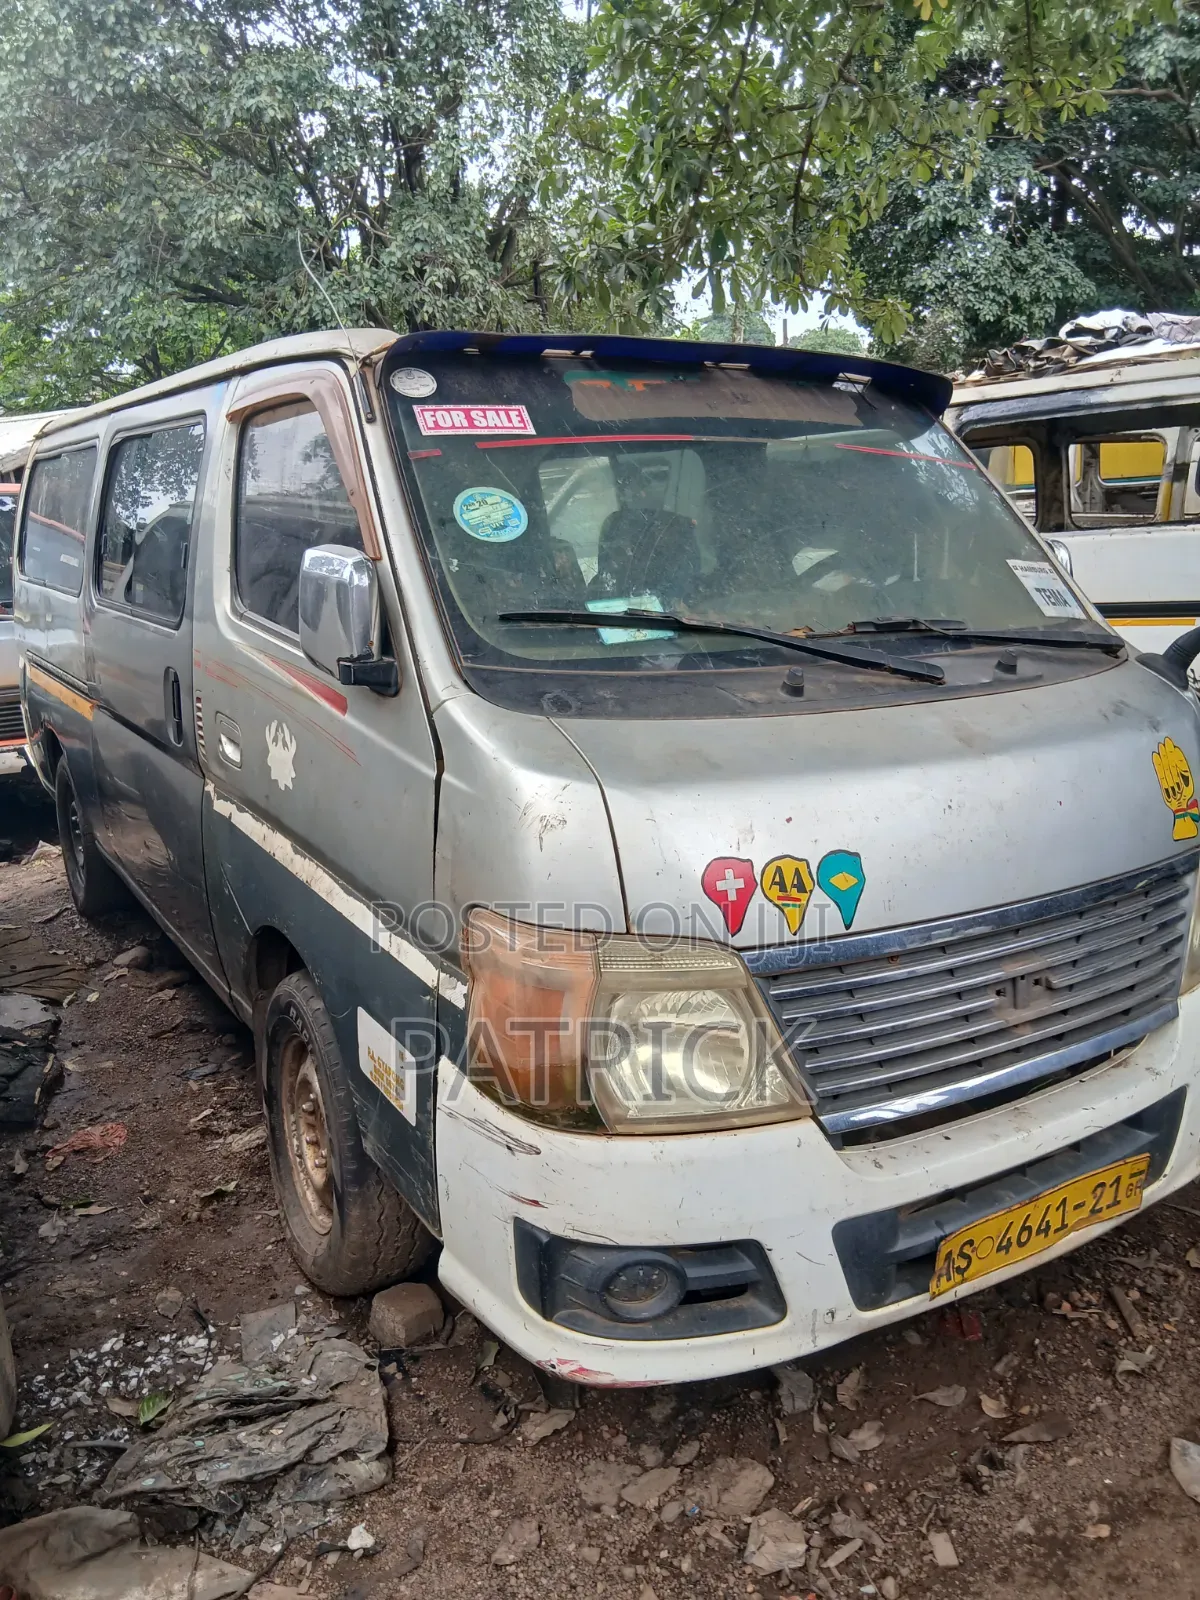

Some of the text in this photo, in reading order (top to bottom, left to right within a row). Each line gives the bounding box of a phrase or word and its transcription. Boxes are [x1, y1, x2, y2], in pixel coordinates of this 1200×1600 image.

[423, 410, 524, 428] FOR SALE
[1034, 587, 1072, 608] TEMA
[768, 865, 808, 894] AA
[936, 1174, 1142, 1283] AS 4641-21 GH
